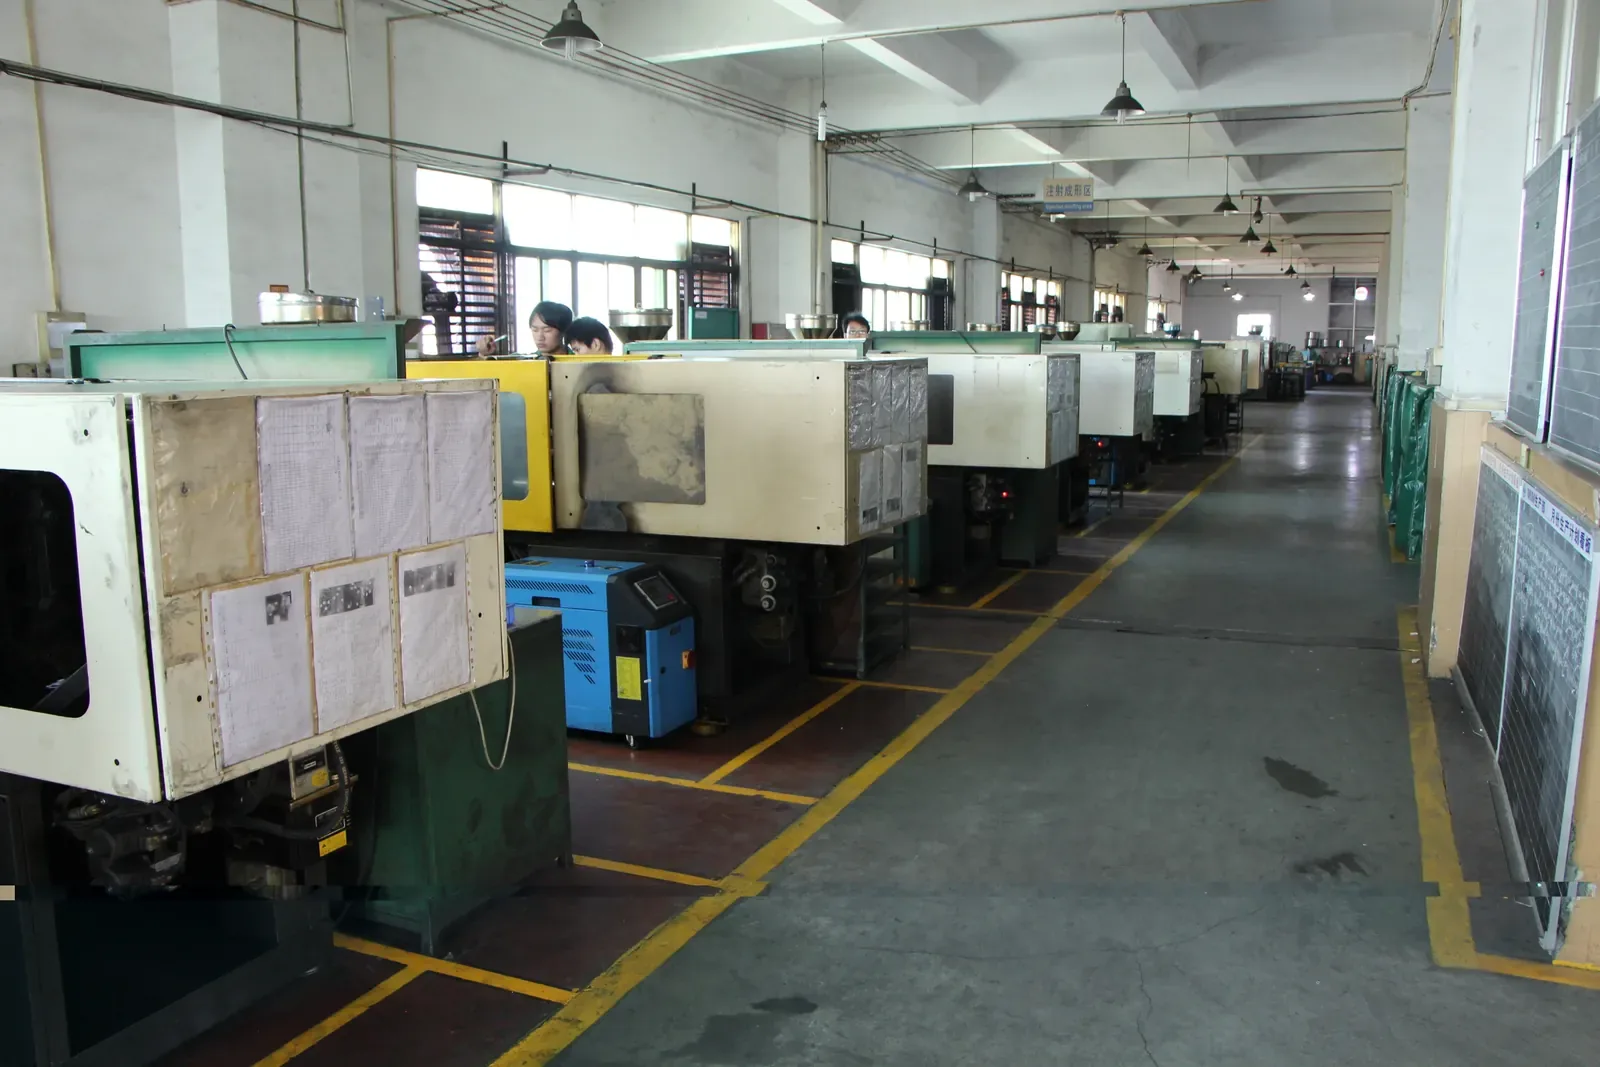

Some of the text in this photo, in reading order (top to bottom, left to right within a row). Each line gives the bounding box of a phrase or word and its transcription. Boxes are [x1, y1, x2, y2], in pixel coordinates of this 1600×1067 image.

[1046, 184, 1092, 197] 注射成形区
